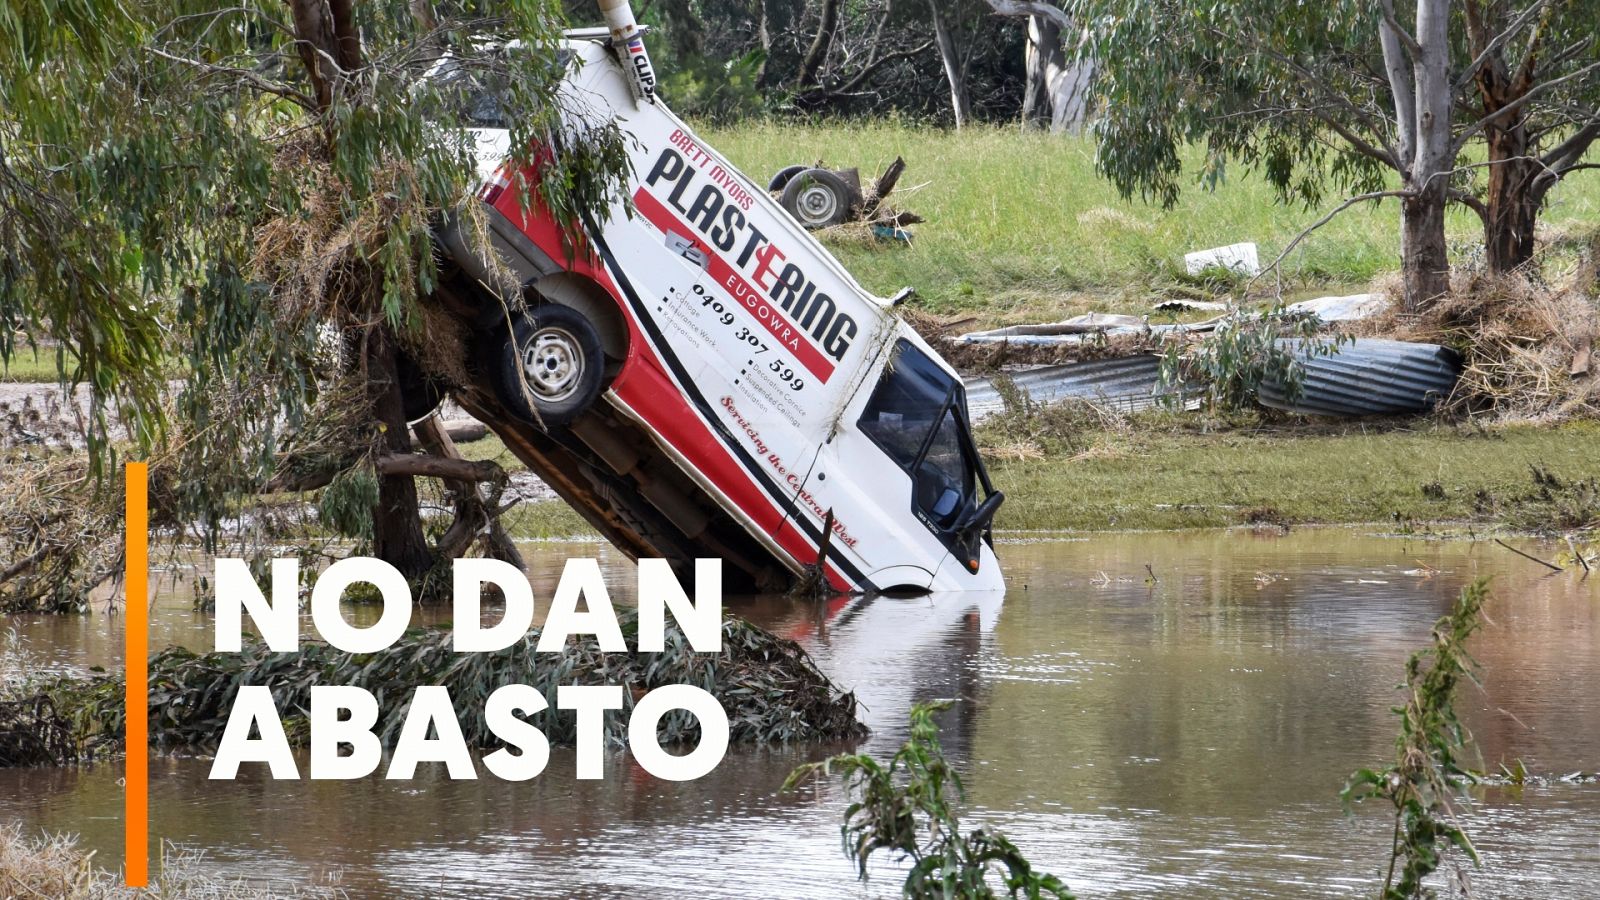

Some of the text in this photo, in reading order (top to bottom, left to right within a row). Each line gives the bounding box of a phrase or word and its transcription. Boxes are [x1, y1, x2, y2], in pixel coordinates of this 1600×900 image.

[669, 128, 754, 211] BRETT MYORS
[646, 147, 858, 362] PLASTERING
[668, 302, 699, 332] Insurance
[675, 292, 700, 318] Cottage
[692, 283, 804, 391] 0409 307 599
[726, 275, 799, 350] EUGOWRA
[739, 383, 768, 413] Insulation
[745, 373, 801, 428] Suspended Ceilings
[753, 363, 806, 416] Decorative Cornice
[720, 395, 768, 455] Servicing
[768, 454, 786, 475] the
[831, 518, 859, 548] West
